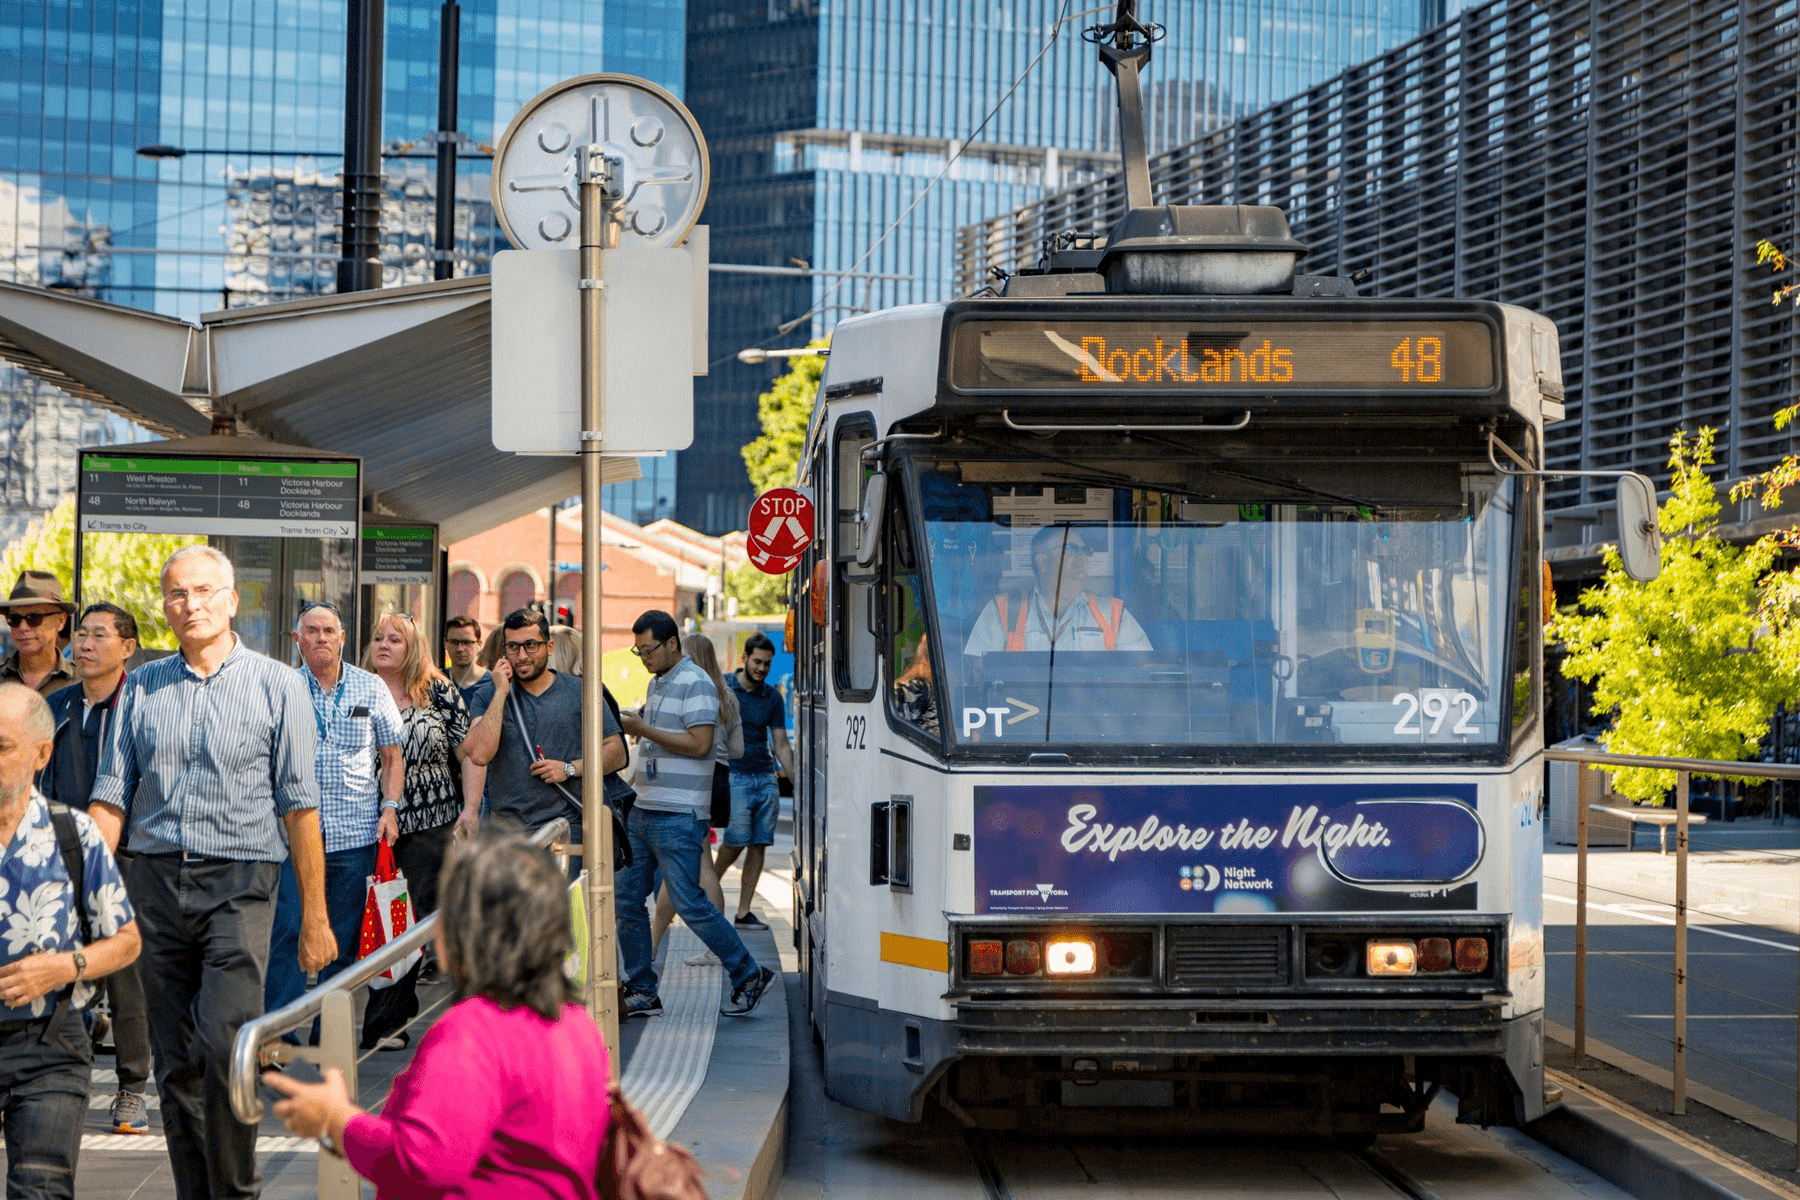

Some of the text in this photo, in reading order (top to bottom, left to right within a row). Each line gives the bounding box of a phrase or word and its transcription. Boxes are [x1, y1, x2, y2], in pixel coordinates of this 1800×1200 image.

[1390, 336, 1442, 383] 48
[89, 474, 177, 483] 11 West Preston
[239, 477, 343, 488] 11 Victoria Harbour
[280, 487, 321, 495] Docklands
[88, 496, 177, 507] 48 North Balwyn
[238, 499, 343, 510] 48 Victoria Harbour
[760, 497, 807, 515] STOP
[280, 509, 321, 518] Docklands
[99, 521, 147, 531] Trams to City
[280, 526, 338, 536] Trams from City
[1391, 692, 1481, 735] 292
[845, 715, 867, 750] 292
[1061, 803, 1392, 862] Explore the Night.
[1224, 866, 1256, 880] Night
[1224, 878, 1274, 890] Network
